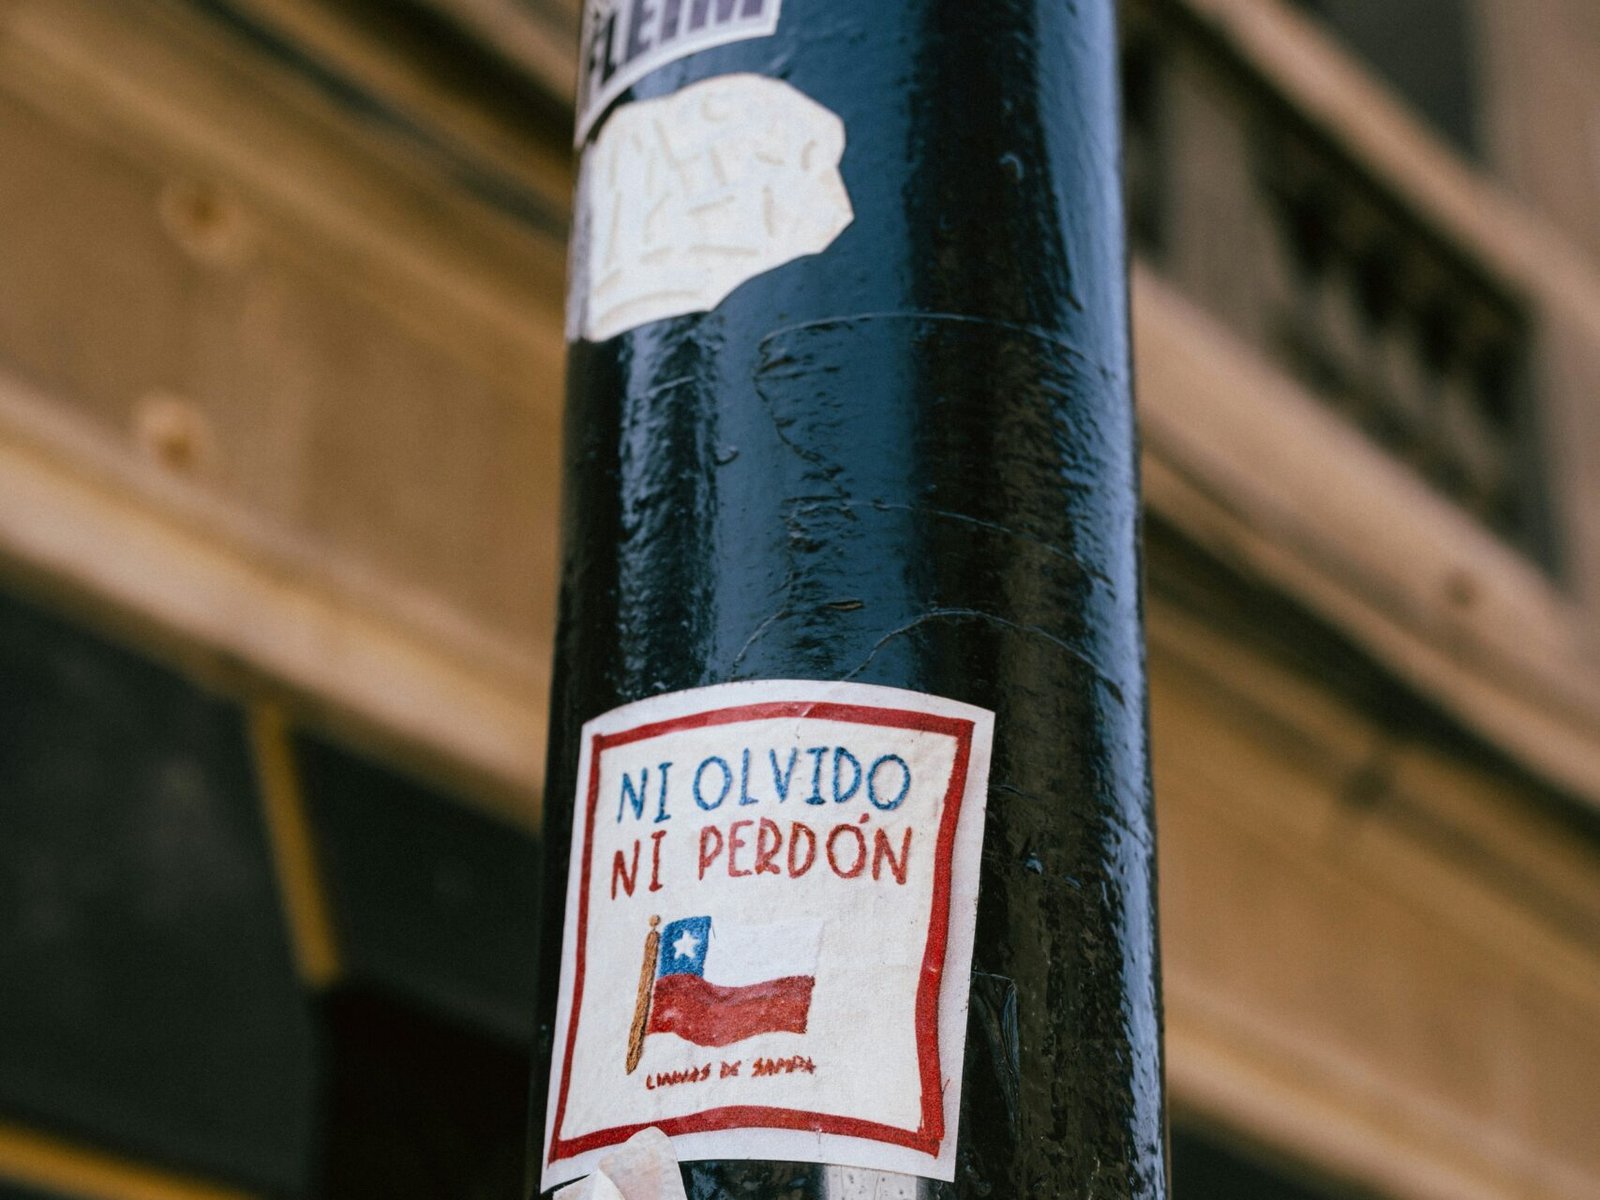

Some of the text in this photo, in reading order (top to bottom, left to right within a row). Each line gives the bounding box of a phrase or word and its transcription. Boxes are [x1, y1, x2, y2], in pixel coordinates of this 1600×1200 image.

[616, 746, 911, 823] NI OLVIDO
[611, 813, 913, 900] NI PERDÓN
